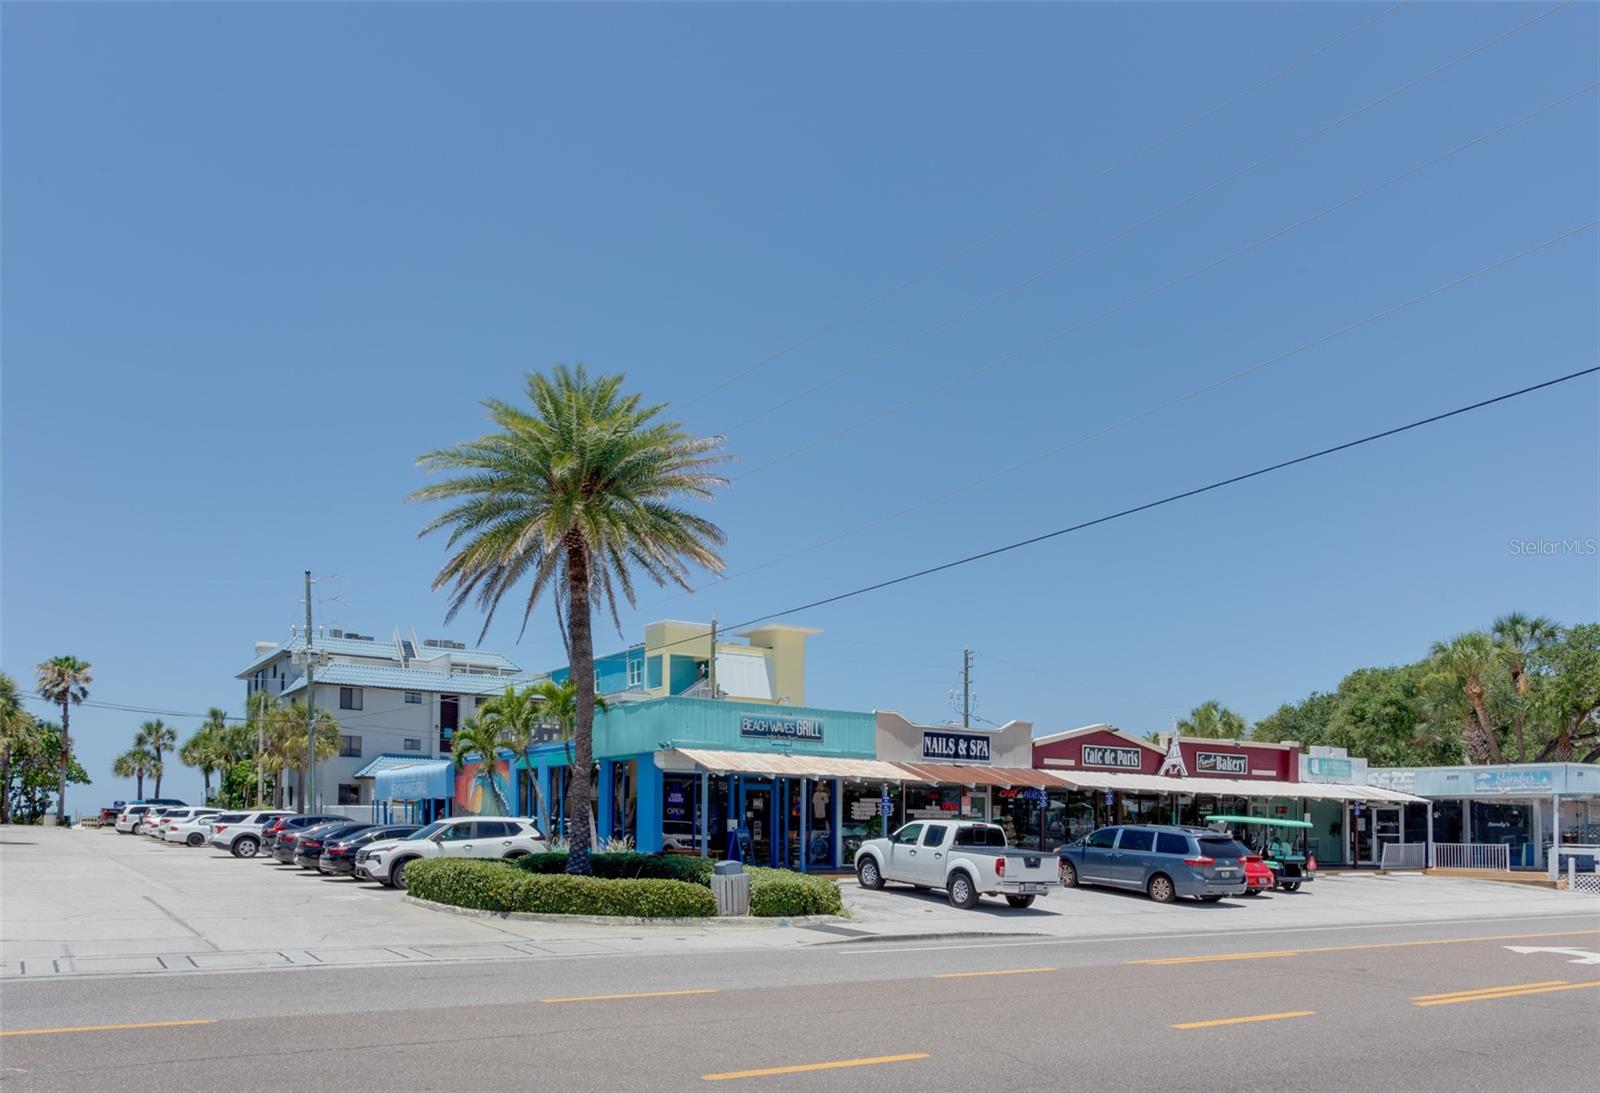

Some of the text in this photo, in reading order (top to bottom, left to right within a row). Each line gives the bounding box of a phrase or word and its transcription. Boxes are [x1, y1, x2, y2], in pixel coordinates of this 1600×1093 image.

[742, 718, 821, 737] BEACH WAVES GRILL
[924, 736, 988, 756] NAILS & SPA
[1104, 749, 1115, 765] de
[1117, 750, 1138, 766] Paris
[1216, 755, 1246, 773] Bakery
[666, 807, 685, 815] OPEN
